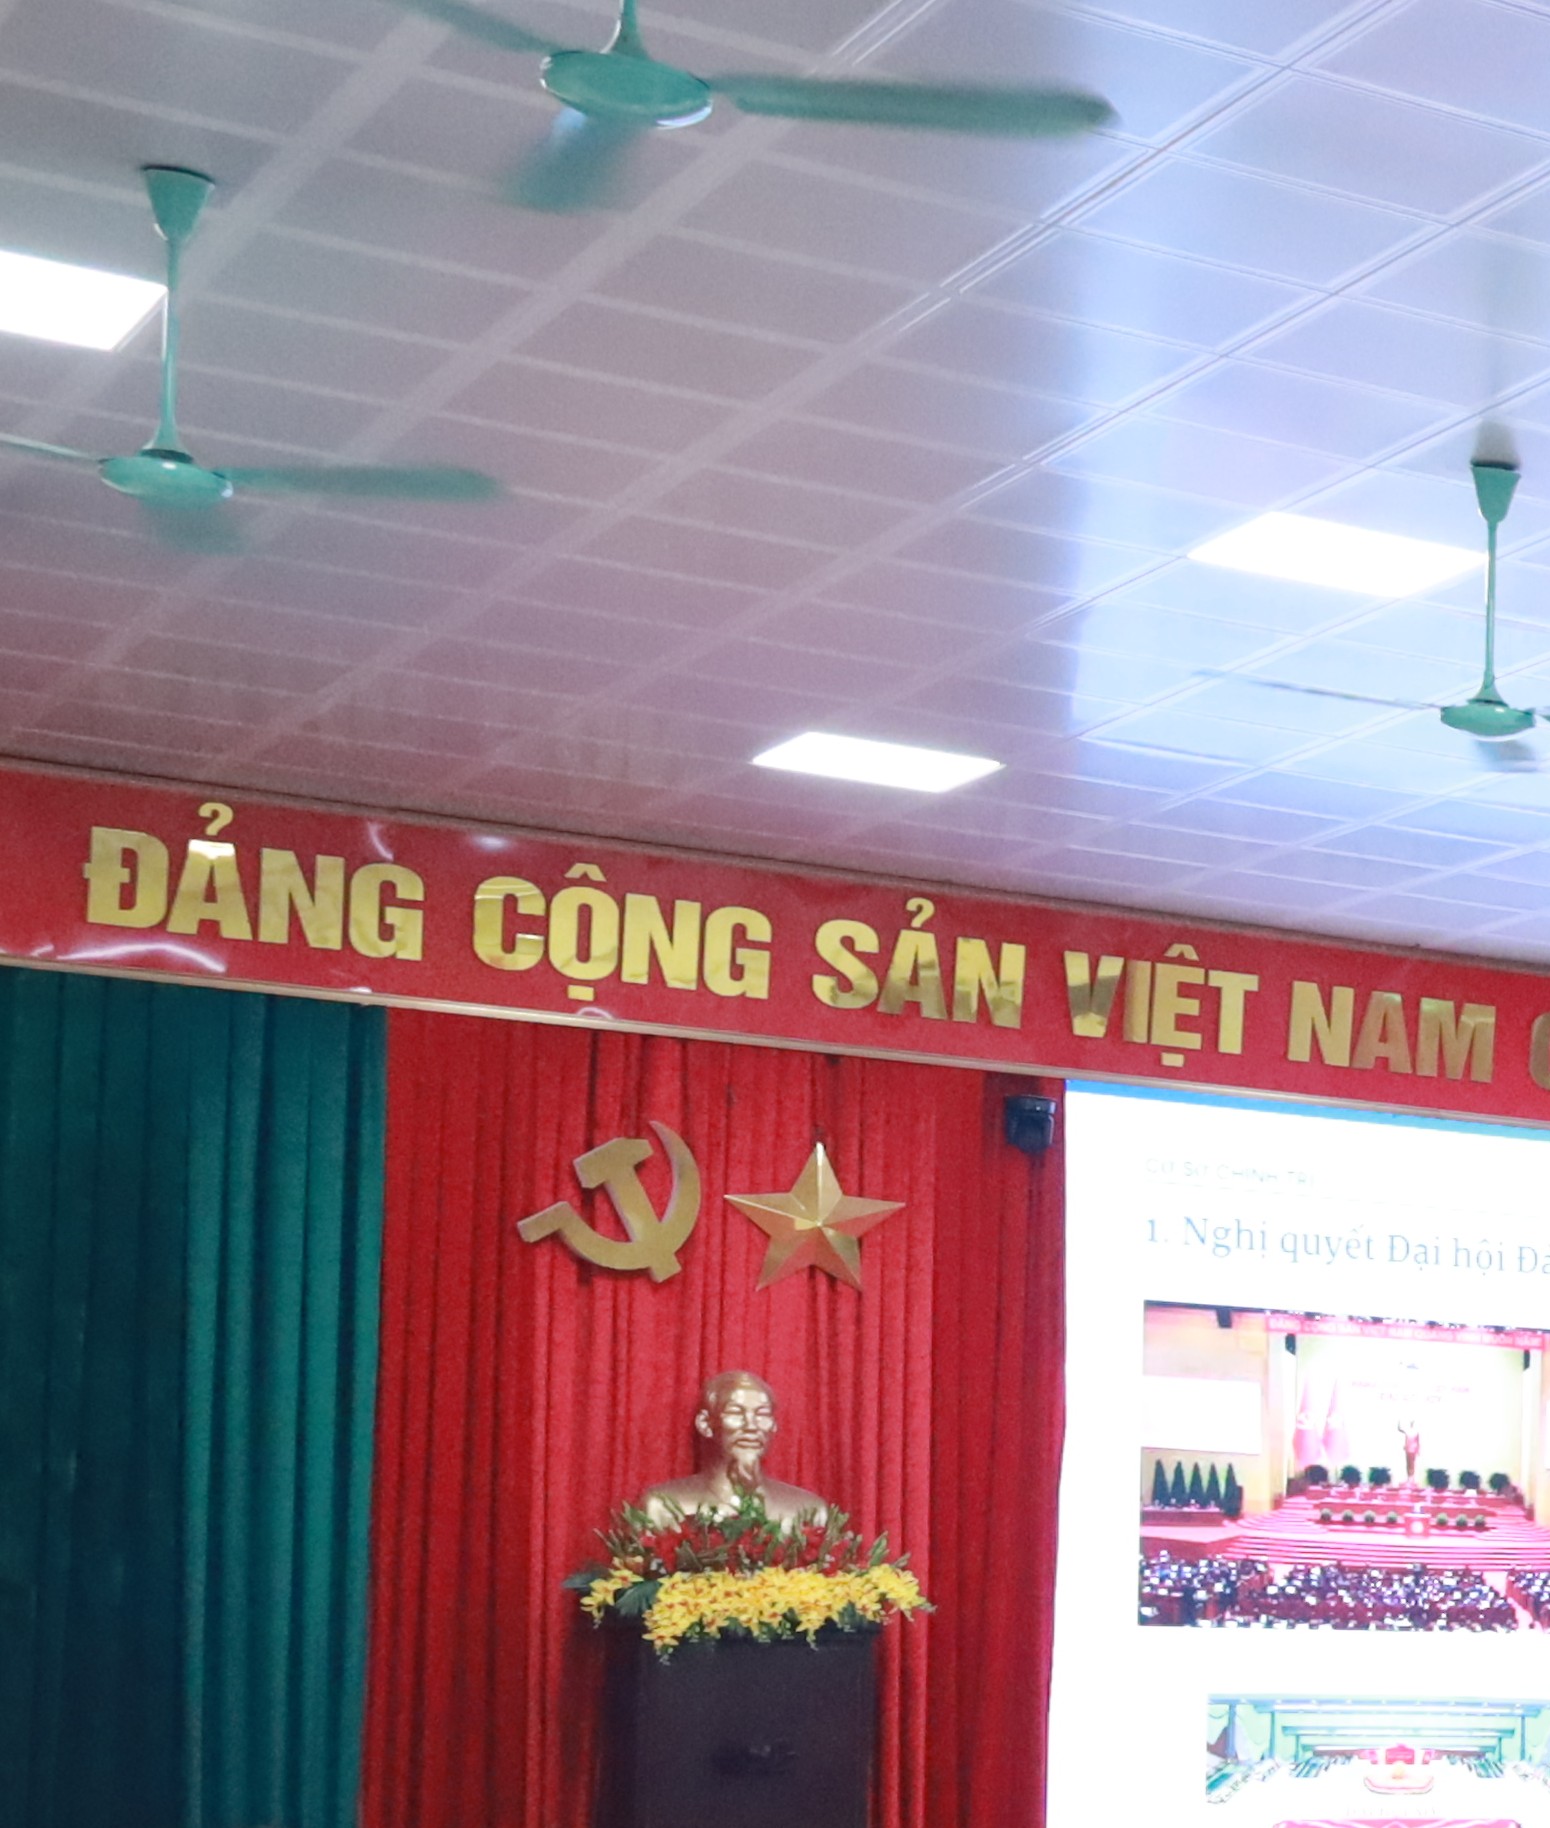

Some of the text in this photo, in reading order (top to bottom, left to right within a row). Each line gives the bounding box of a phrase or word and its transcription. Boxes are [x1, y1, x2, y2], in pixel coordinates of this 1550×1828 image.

[83, 802, 425, 960] ĐẢNG
[472, 863, 769, 1002] CỘNG
[812, 897, 1025, 1028] SẢN
[1063, 944, 1259, 1065] VIỆT
[1289, 981, 1496, 1083] NAM
[1184, 1216, 1267, 1258] Nghị
[1280, 1225, 1374, 1265] quyết
[1388, 1235, 1440, 1271] Đại
[1453, 1238, 1504, 1276] hội
